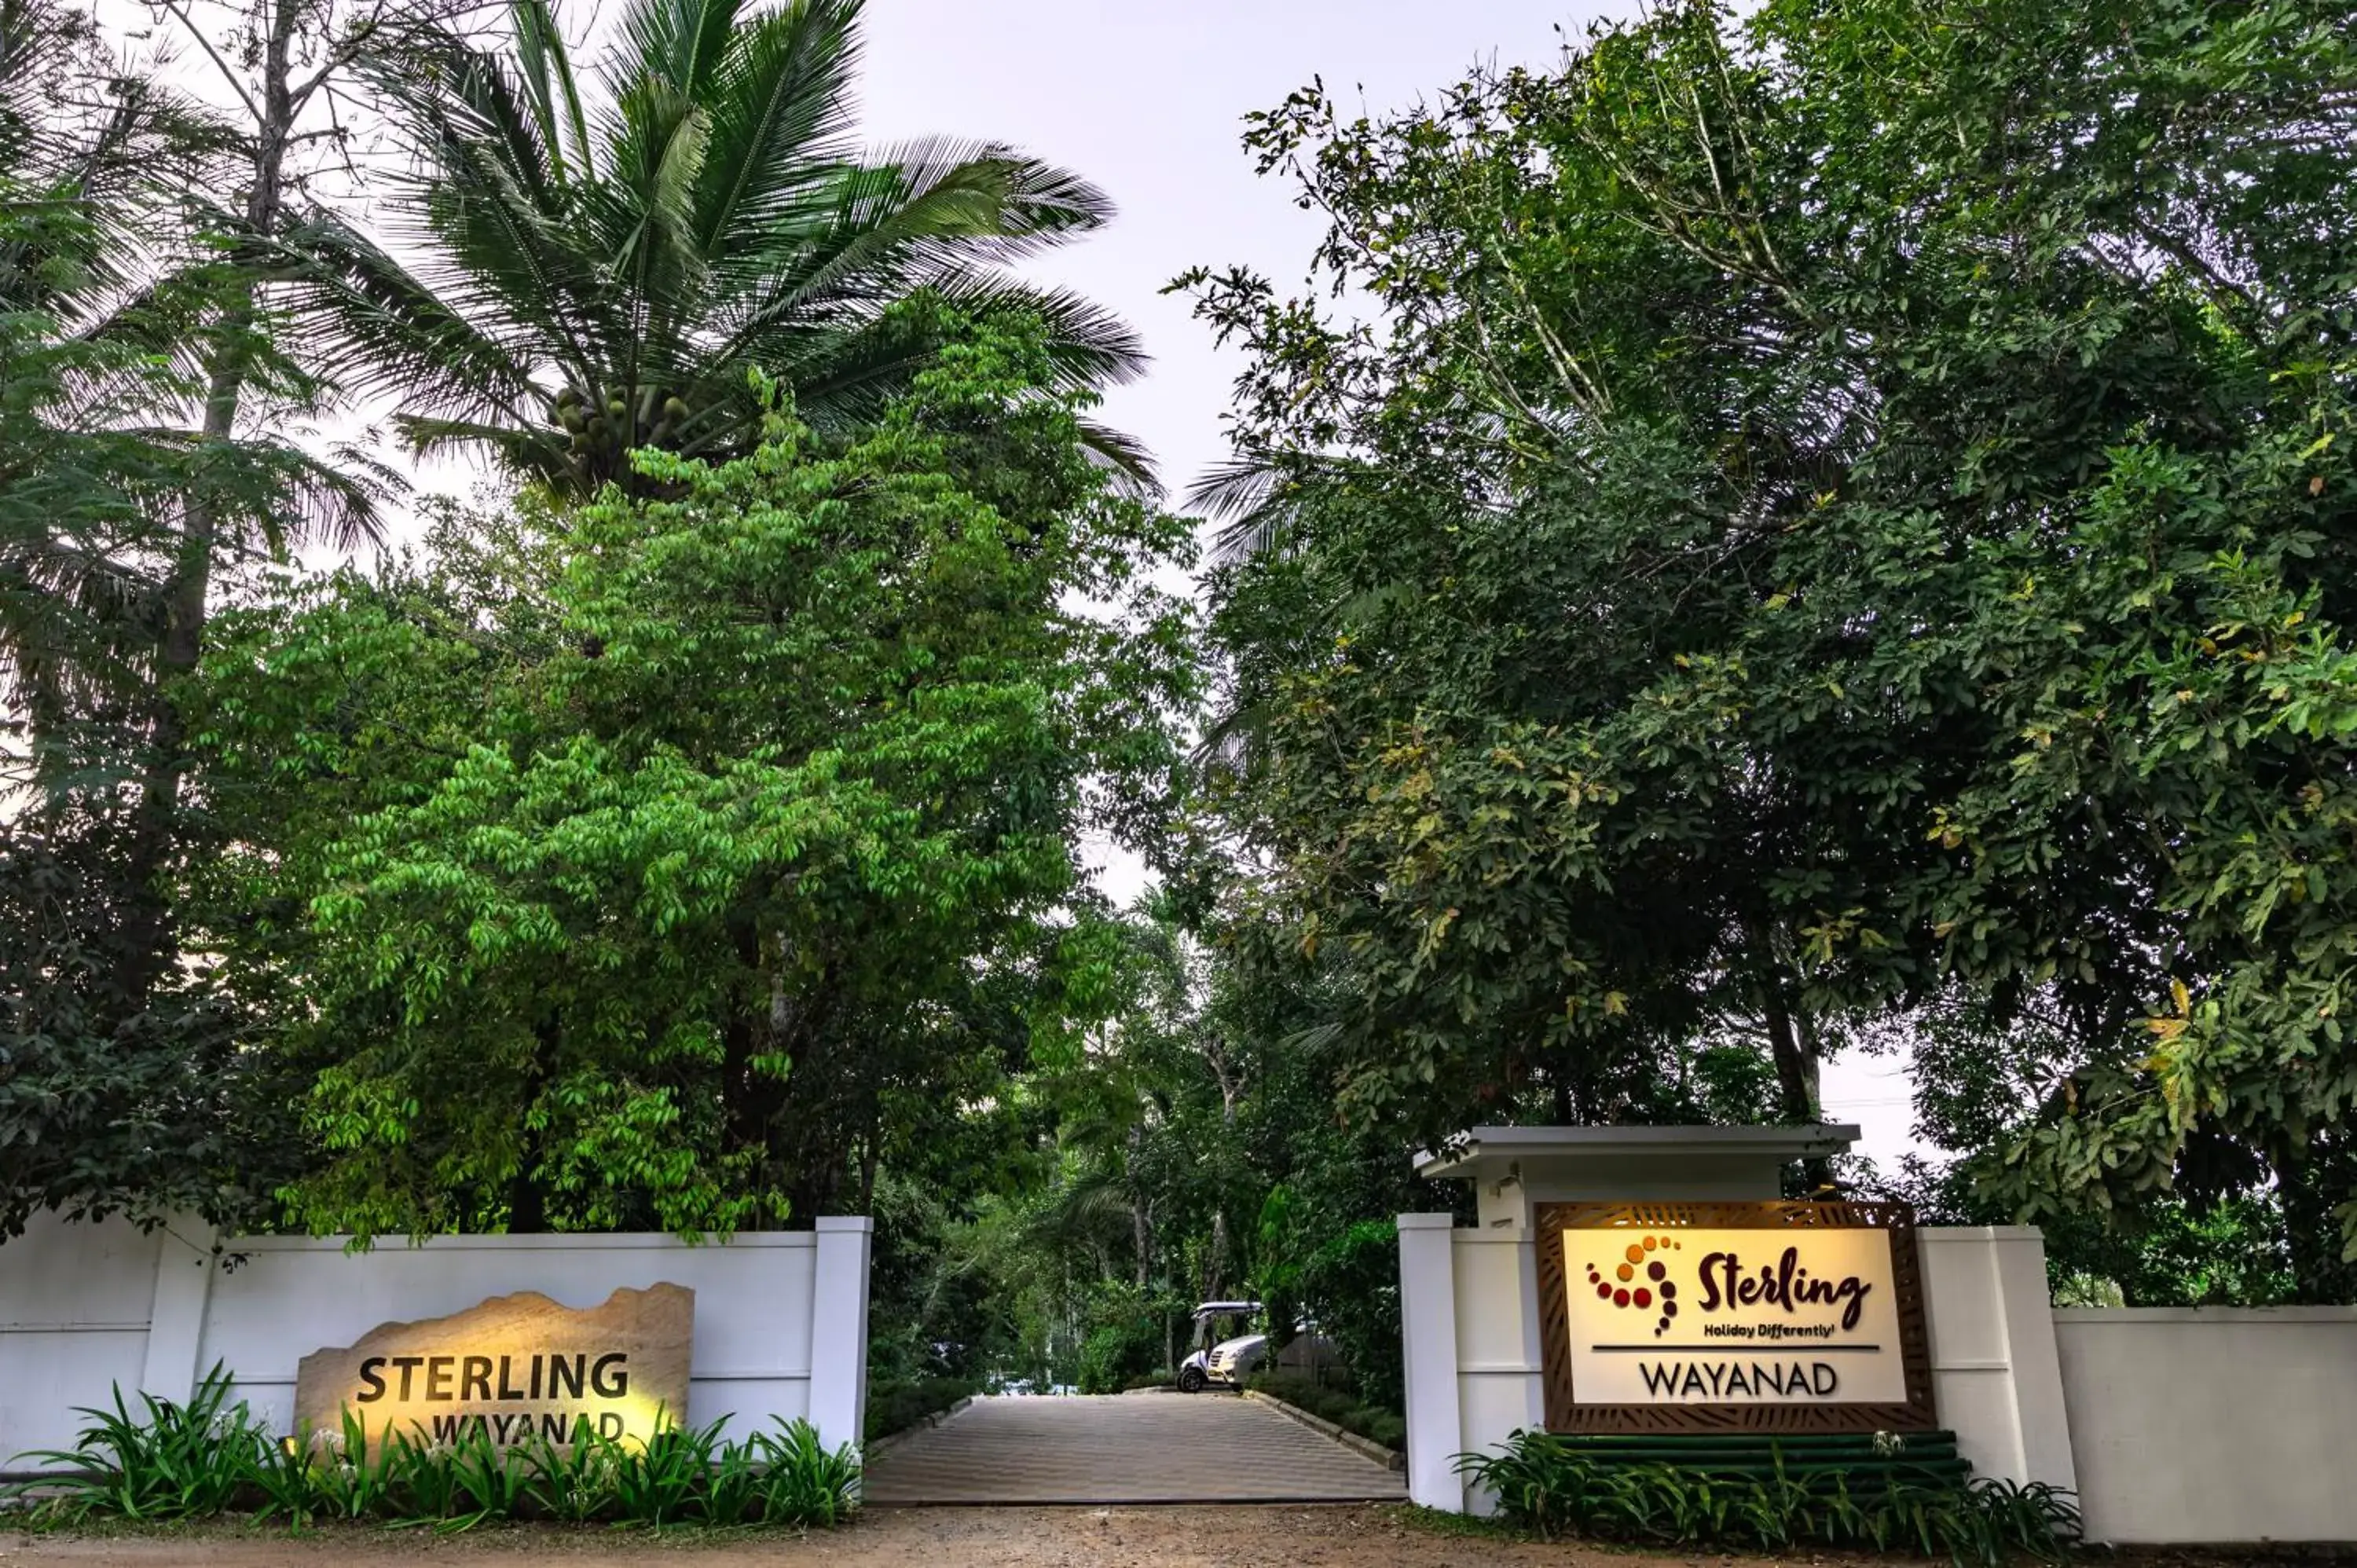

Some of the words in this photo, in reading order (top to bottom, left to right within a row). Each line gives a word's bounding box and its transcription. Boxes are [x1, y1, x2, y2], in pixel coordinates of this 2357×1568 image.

[1698, 1247, 1871, 1330] Sterling
[1704, 1324, 1754, 1339] Holiday
[357, 1353, 628, 1402] STERLING
[1638, 1361, 1837, 1396] WAYANAD
